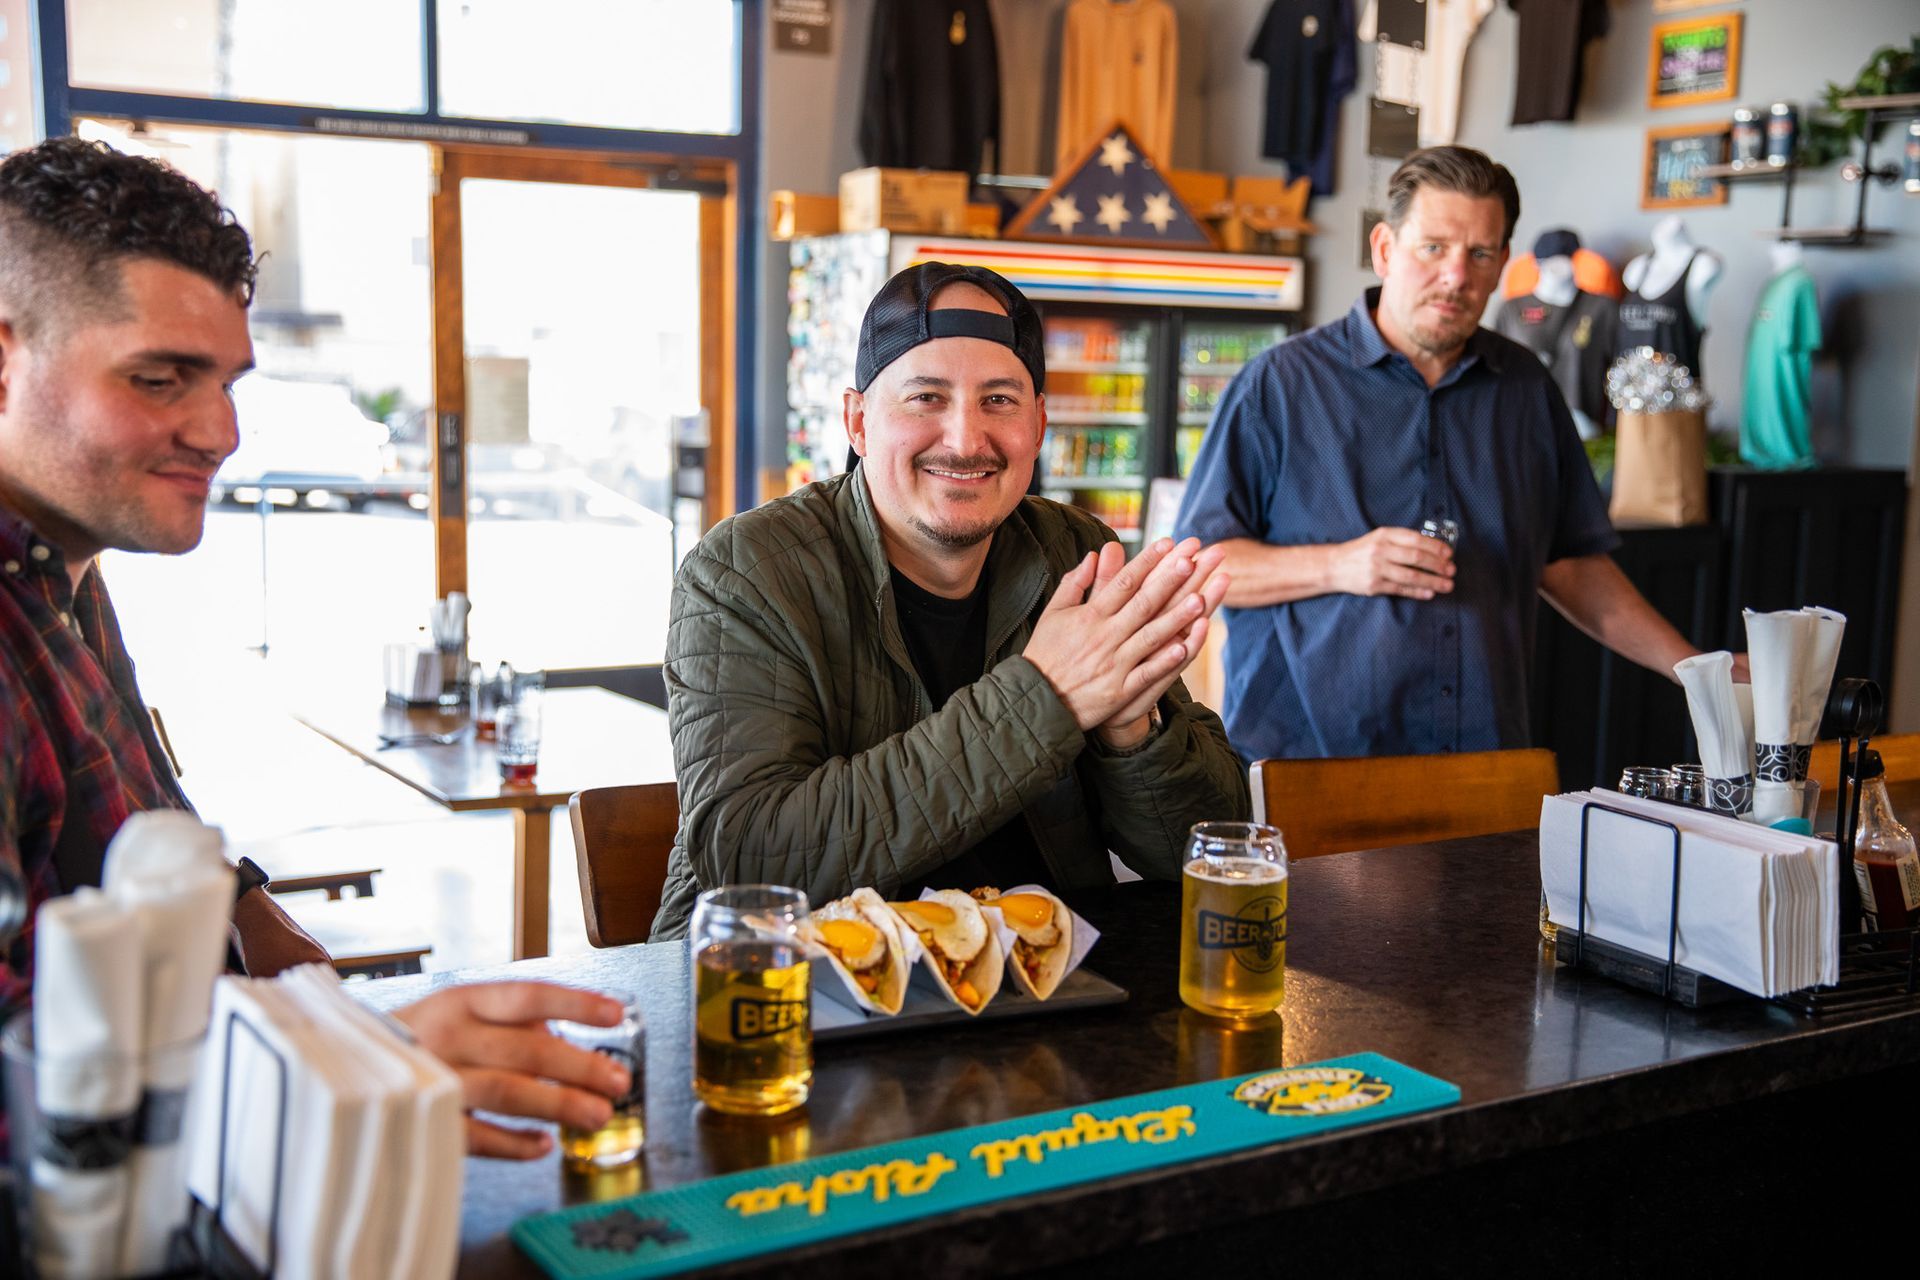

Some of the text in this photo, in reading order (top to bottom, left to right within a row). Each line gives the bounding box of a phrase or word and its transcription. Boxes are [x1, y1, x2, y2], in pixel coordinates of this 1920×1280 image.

[1204, 915, 1259, 945] BEER
[726, 1104, 1196, 1216] Liquid Aloha
